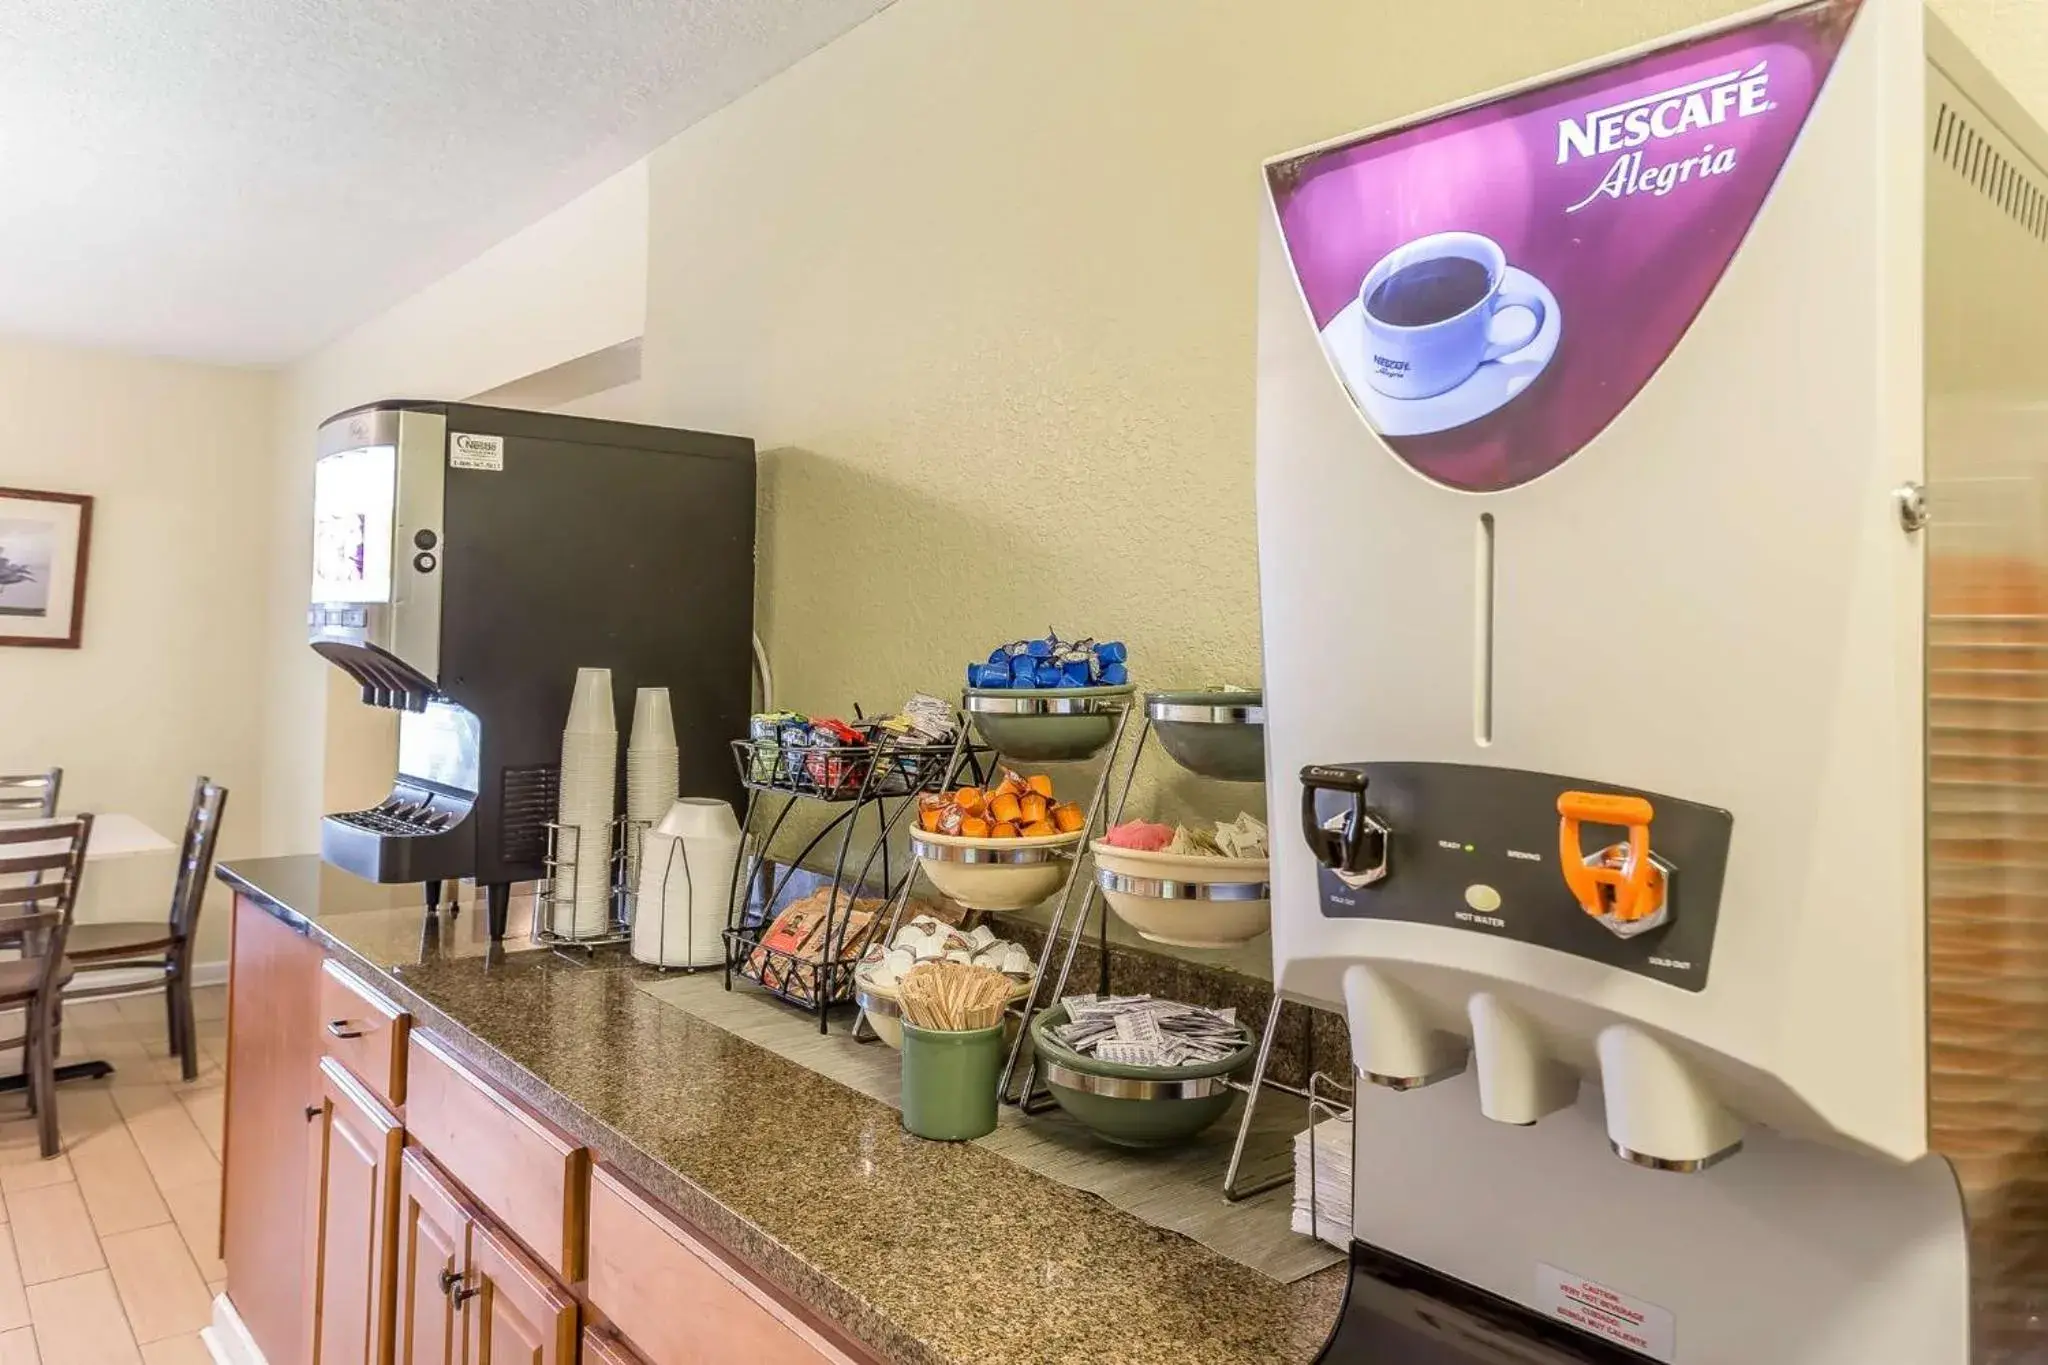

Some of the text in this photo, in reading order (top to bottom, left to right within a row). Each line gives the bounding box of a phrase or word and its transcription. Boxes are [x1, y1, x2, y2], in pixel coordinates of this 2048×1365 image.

[1556, 60, 1770, 165] NESCAFÉ
[1566, 144, 1736, 213] Alegria
[1455, 911, 1505, 928] HOT WATER
